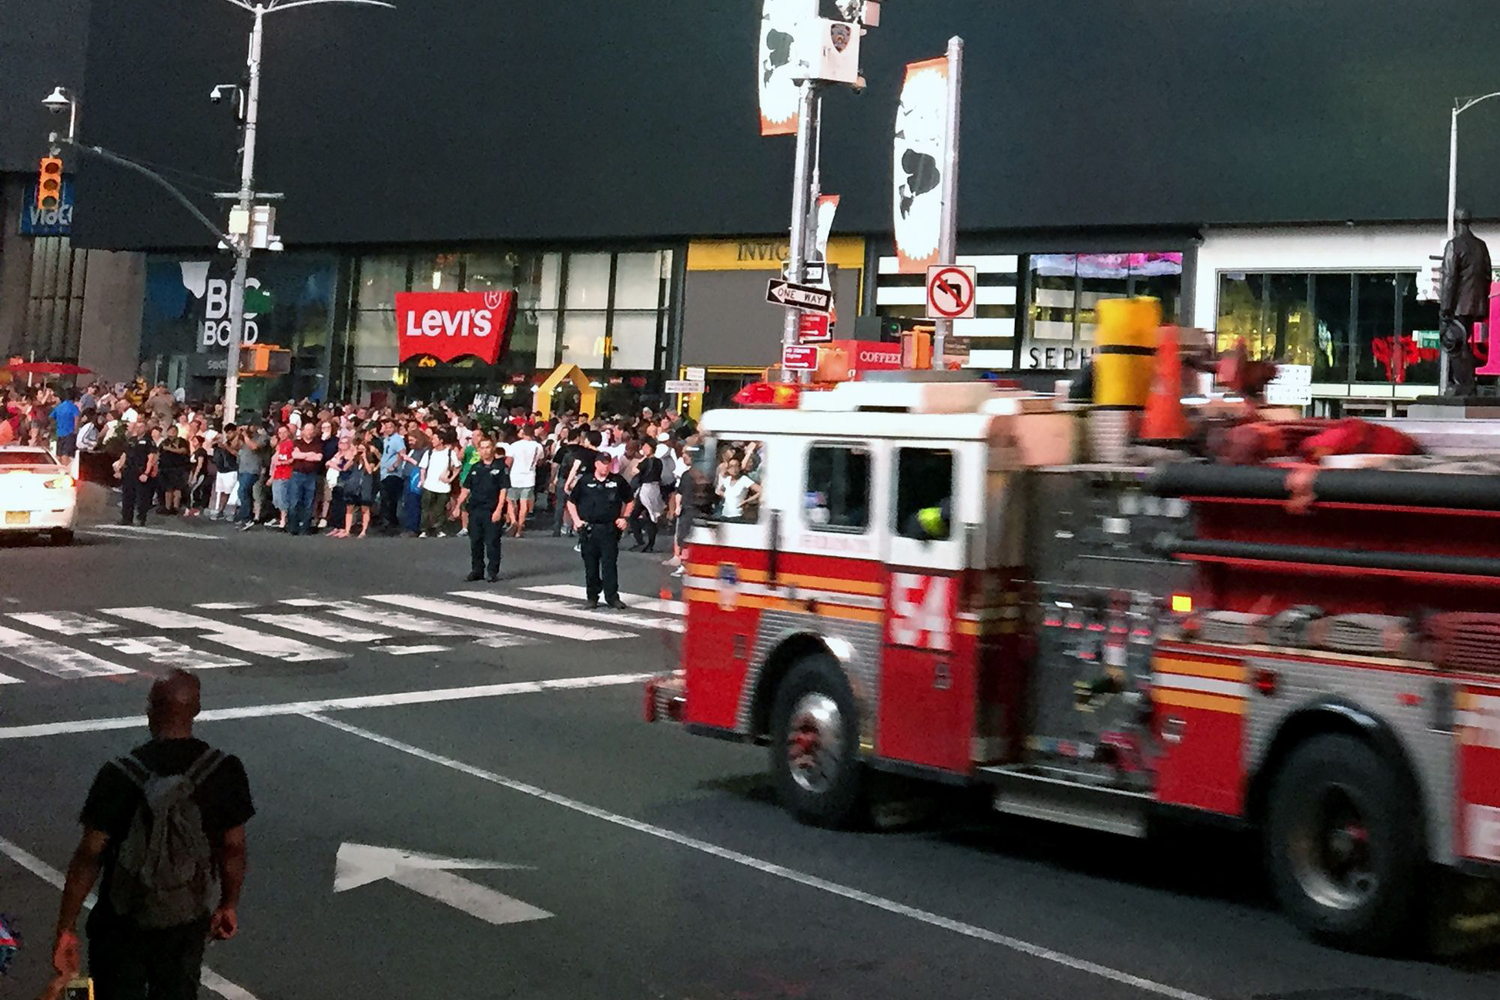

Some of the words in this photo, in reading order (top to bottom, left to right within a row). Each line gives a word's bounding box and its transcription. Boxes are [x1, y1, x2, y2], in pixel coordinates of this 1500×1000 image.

[777, 287, 797, 300] ONE
[804, 292, 823, 306] WAY
[203, 320, 259, 346] BOD
